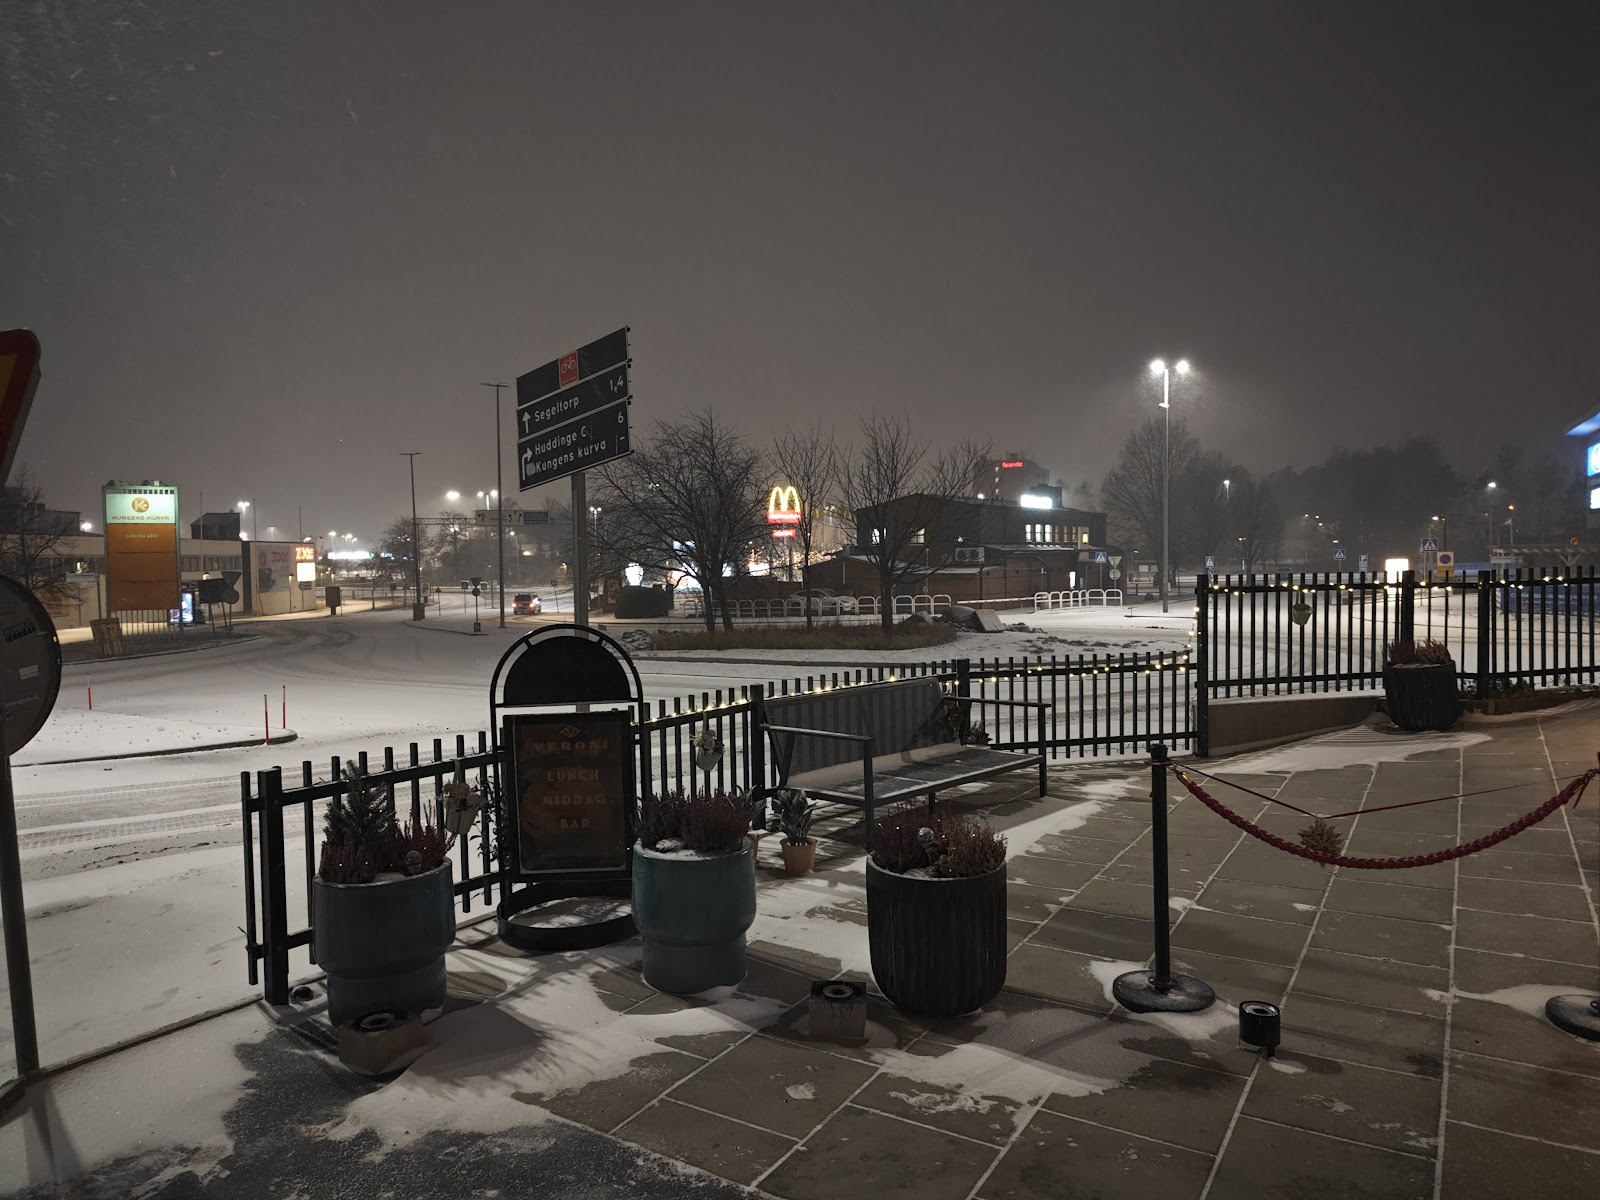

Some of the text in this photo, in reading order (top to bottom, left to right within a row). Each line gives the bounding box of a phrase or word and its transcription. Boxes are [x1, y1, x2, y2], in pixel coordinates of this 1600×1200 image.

[534, 375, 624, 422] Segeltorp 1,4
[534, 411, 624, 455] Huddinge C 6
[535, 450, 574, 473] Kungens
[578, 440, 606, 458] kurva
[534, 740, 608, 753] VERONI
[547, 769, 599, 782] LUNCH
[542, 793, 607, 806] MIDDAG
[560, 818, 591, 829] BAR
